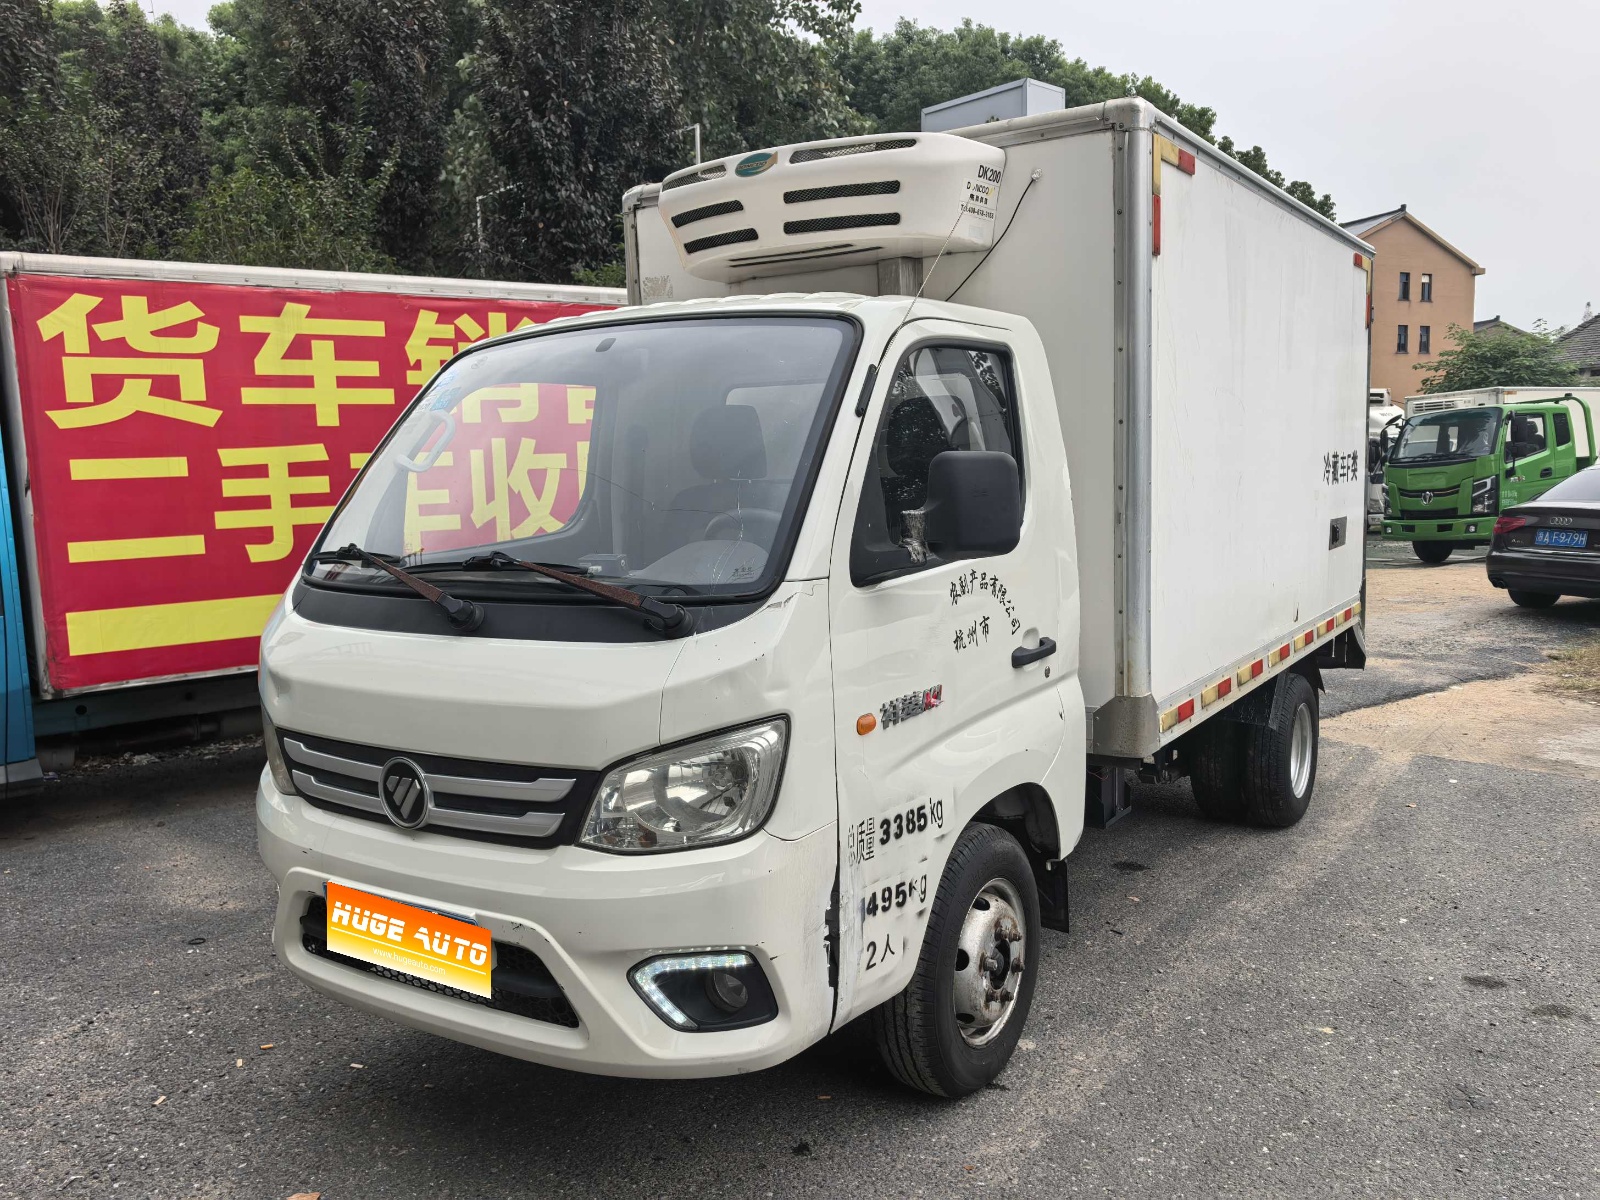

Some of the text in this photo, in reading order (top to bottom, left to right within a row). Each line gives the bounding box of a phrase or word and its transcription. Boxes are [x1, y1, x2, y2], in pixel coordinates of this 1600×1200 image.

[978, 164, 1001, 184] DK200
[37, 292, 596, 429] 货车销
[953, 615, 991, 653] 杭州市
[865, 933, 895, 971] 2人
